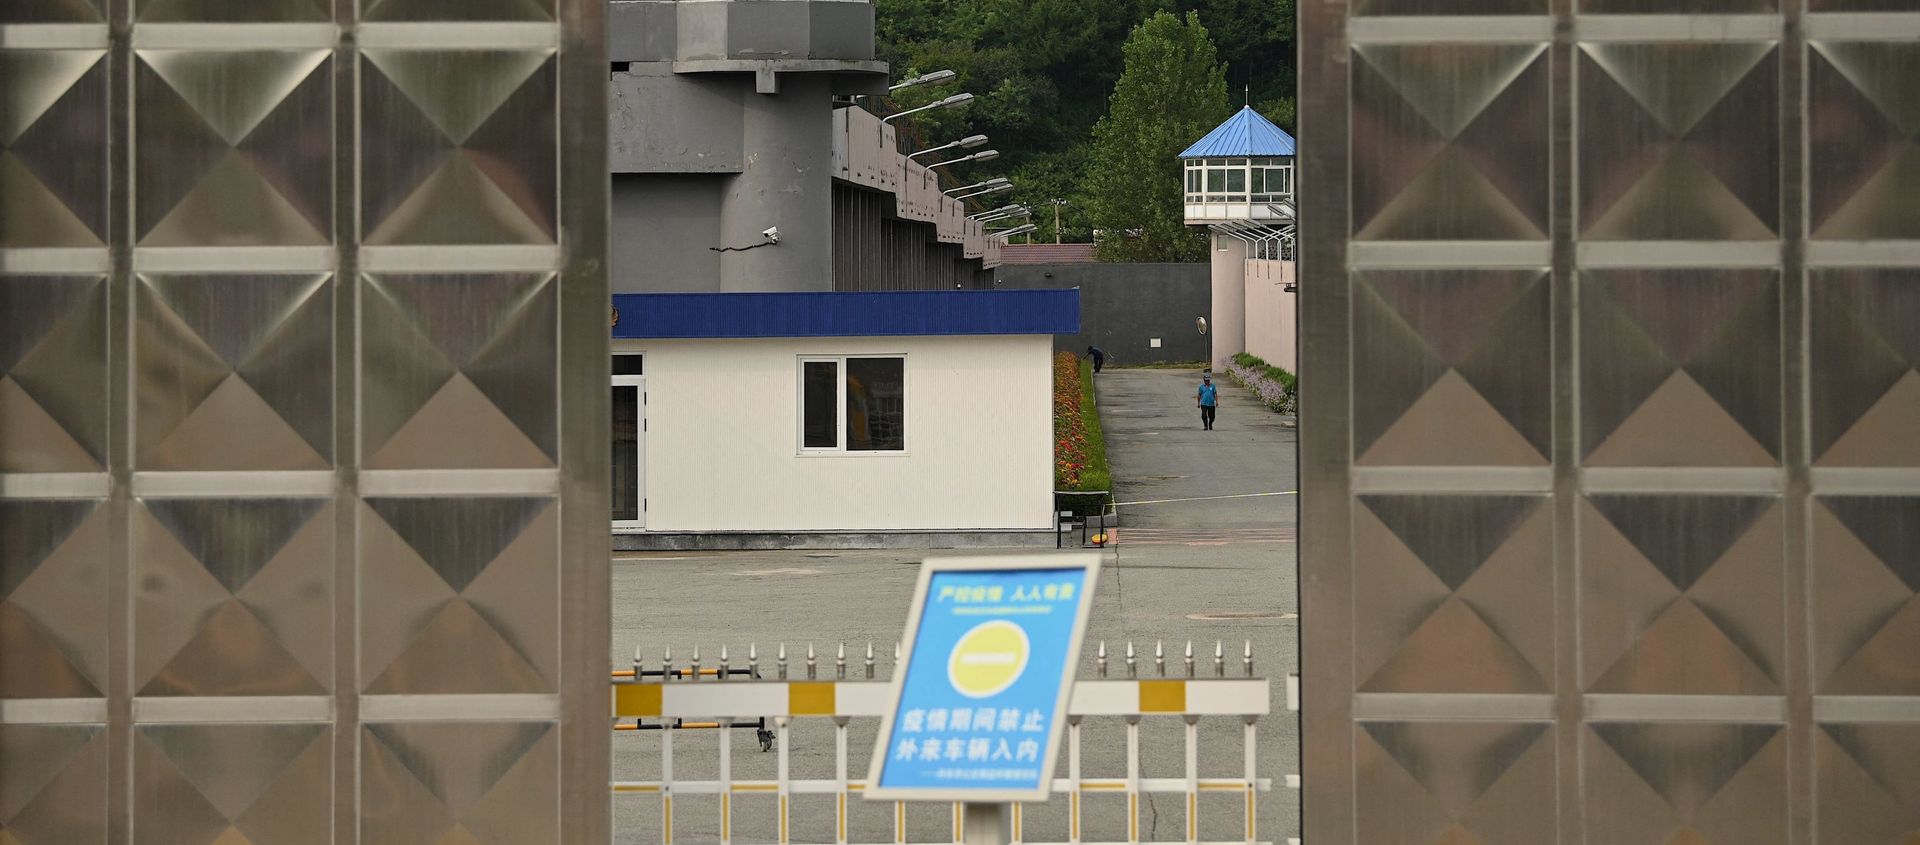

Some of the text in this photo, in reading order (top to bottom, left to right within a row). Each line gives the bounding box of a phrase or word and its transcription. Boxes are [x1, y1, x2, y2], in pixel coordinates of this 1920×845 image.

[902, 707, 1045, 733] 疫情期间禁止
[895, 737, 1039, 761] 外来车辆入内
